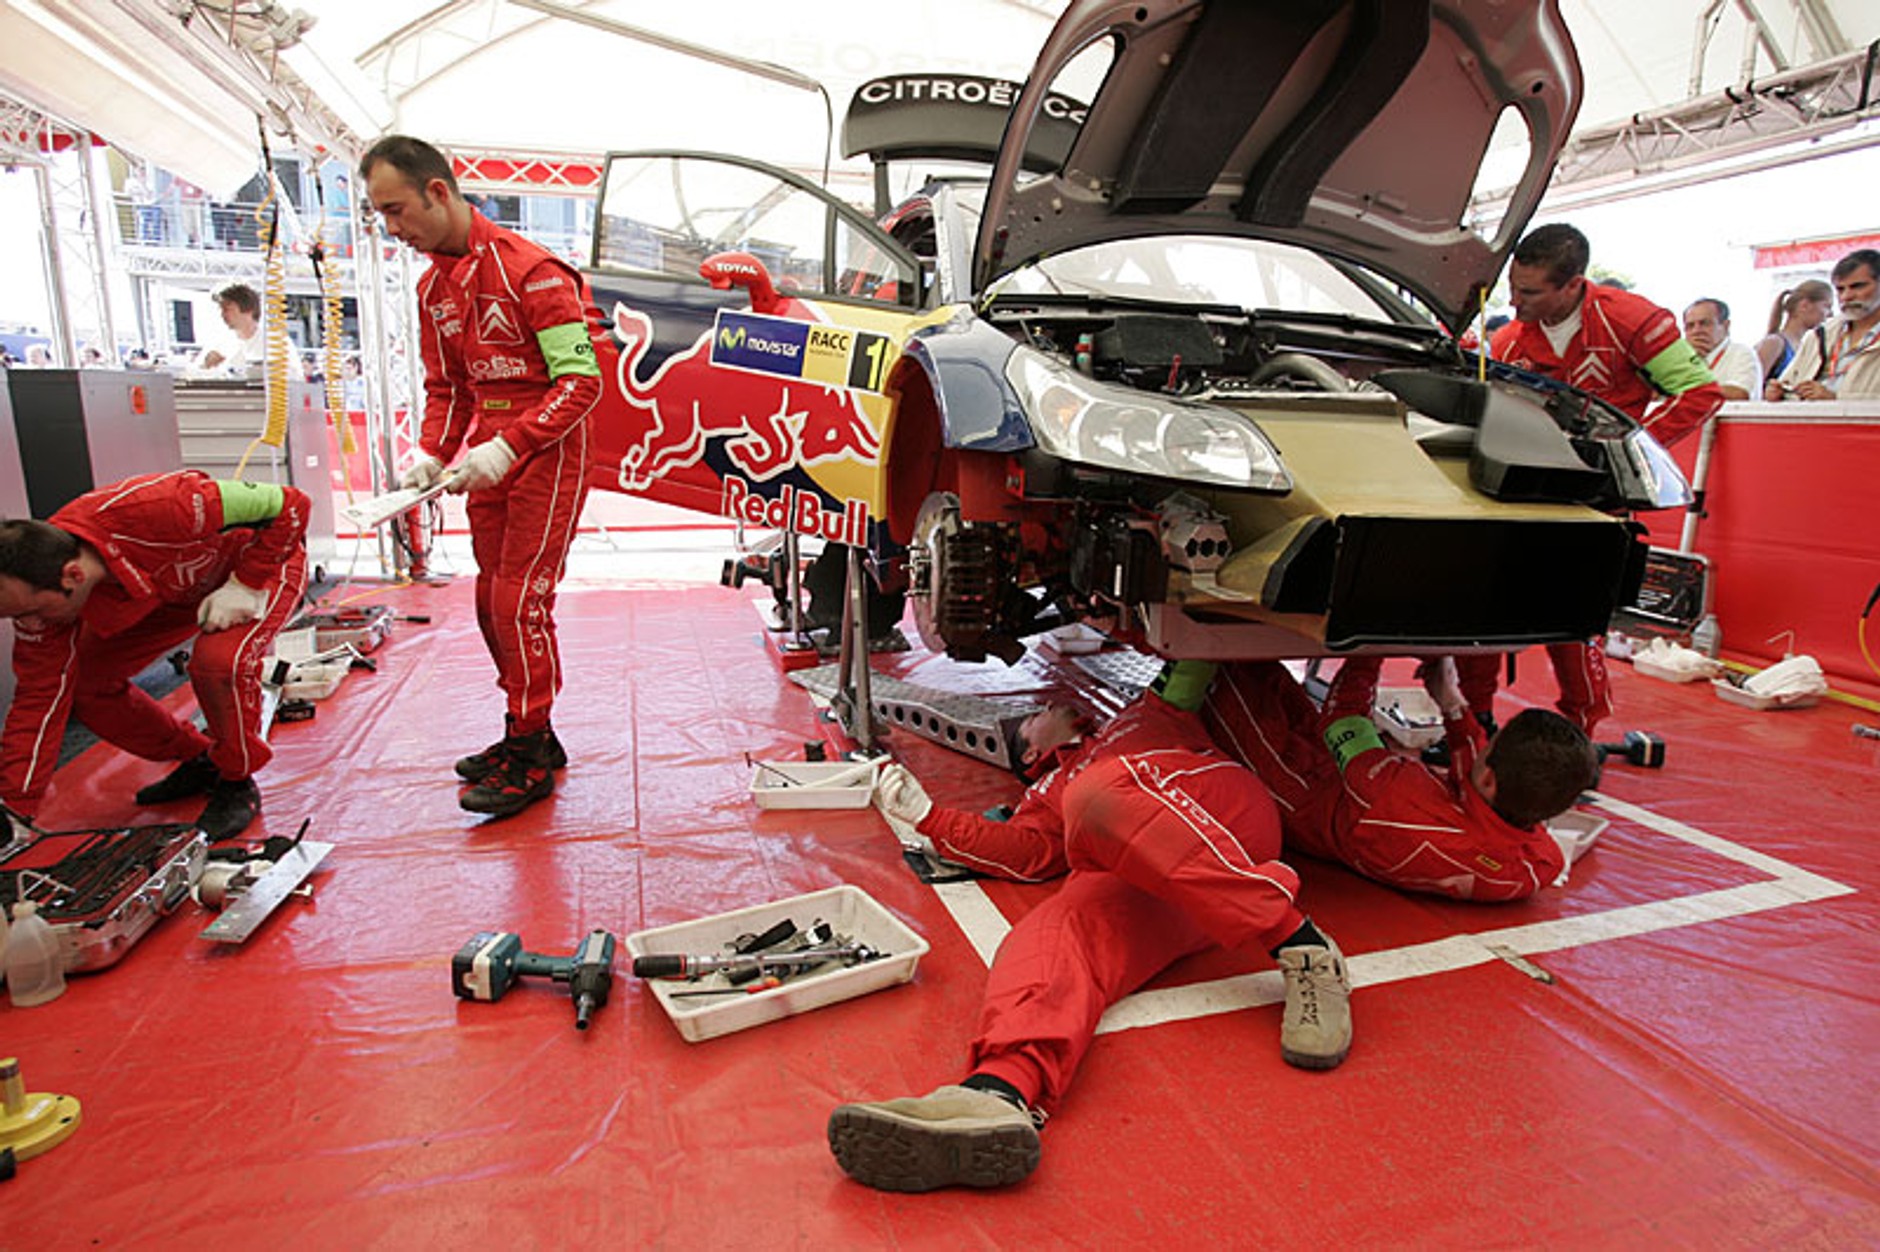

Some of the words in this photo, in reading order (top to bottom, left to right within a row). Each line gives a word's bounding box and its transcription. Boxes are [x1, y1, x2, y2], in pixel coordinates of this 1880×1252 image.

[860, 80, 1020, 105] CITROË
[715, 263, 758, 276] TOTAL
[747, 338, 800, 359] movistar
[810, 331, 849, 351] RACC
[866, 338, 886, 390] 1
[723, 475, 793, 531] Red
[795, 490, 868, 548] Bull
